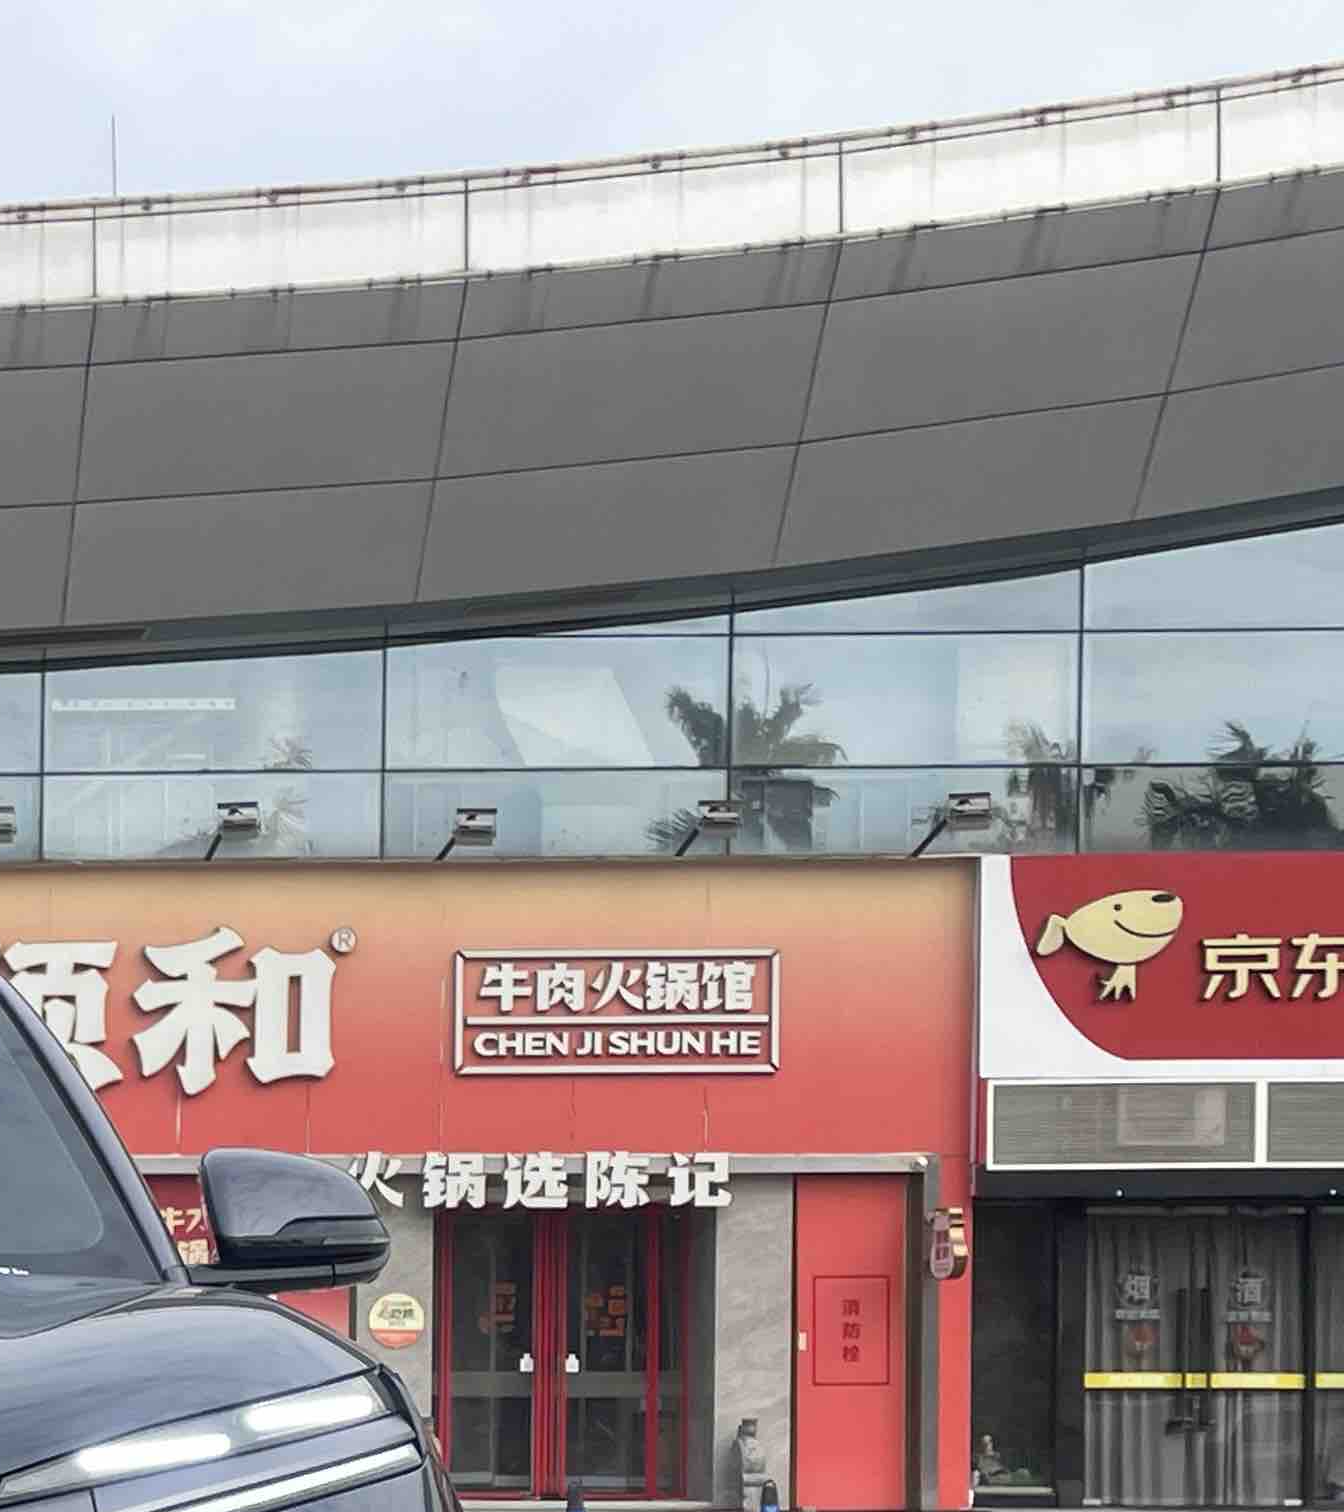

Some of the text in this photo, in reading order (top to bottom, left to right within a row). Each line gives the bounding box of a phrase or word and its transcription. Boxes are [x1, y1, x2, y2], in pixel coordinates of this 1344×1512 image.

[478, 960, 757, 1014] 牛肉火锅馆
[472, 1030, 762, 1058] CHEN JI SHUN HE
[349, 1150, 734, 1210] 火锅选陈记
